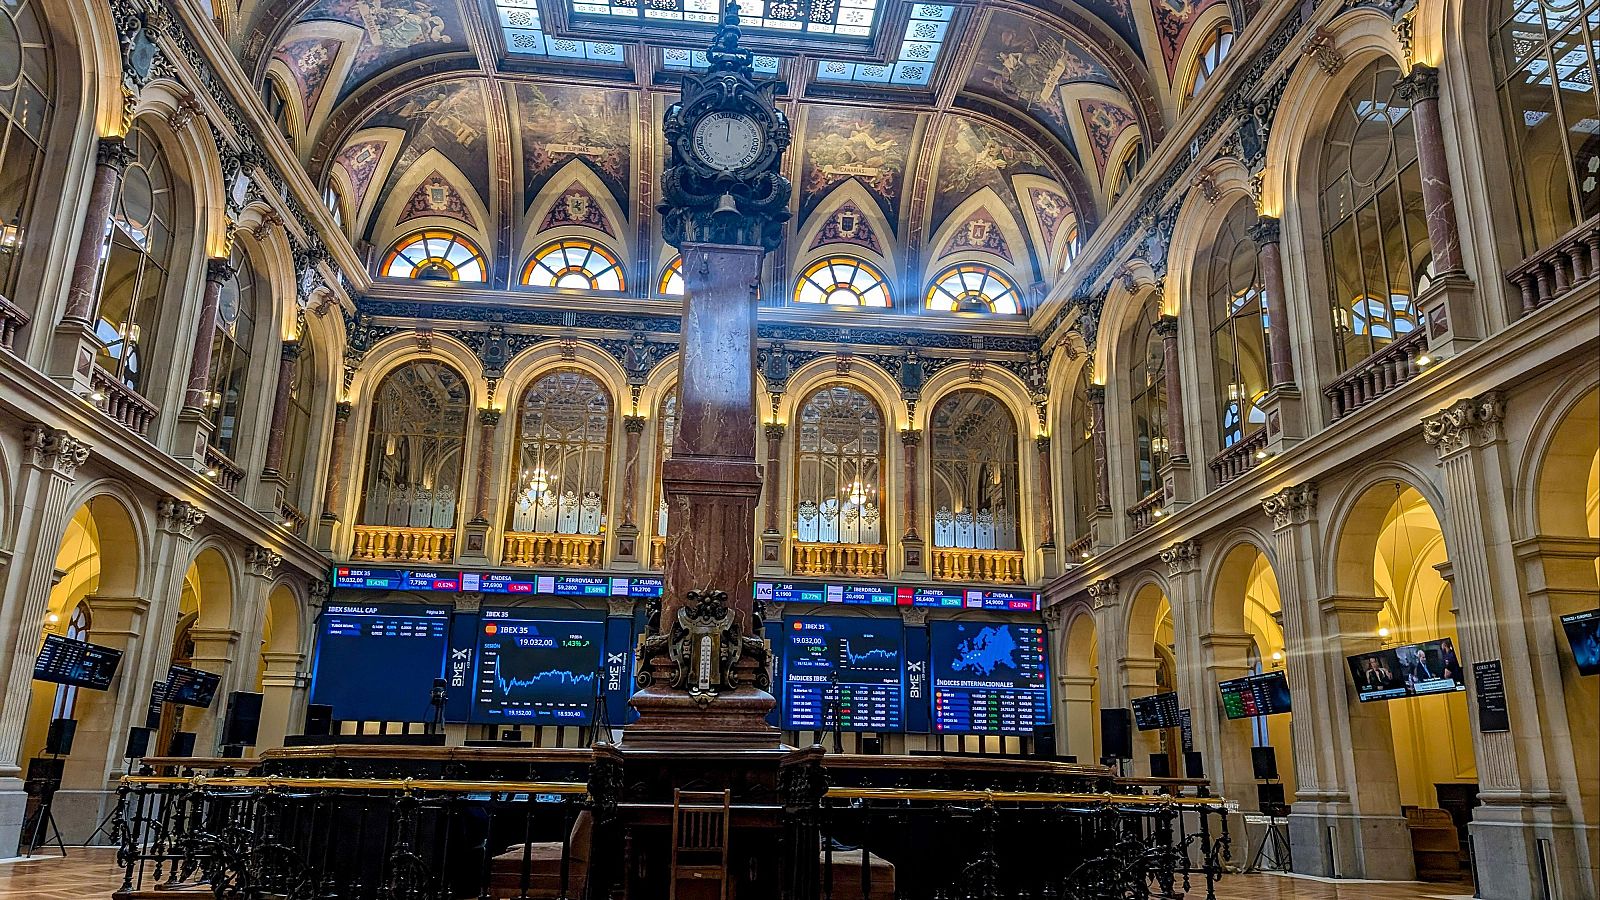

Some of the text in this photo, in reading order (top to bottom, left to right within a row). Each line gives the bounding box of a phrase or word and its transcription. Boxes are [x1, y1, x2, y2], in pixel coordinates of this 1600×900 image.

[712, 112, 745, 122] VARIABLE
[740, 138, 760, 166] MUY SECO
[452, 662, 463, 687] BME
[609, 666, 619, 690] BME
[910, 674, 919, 698] BME
